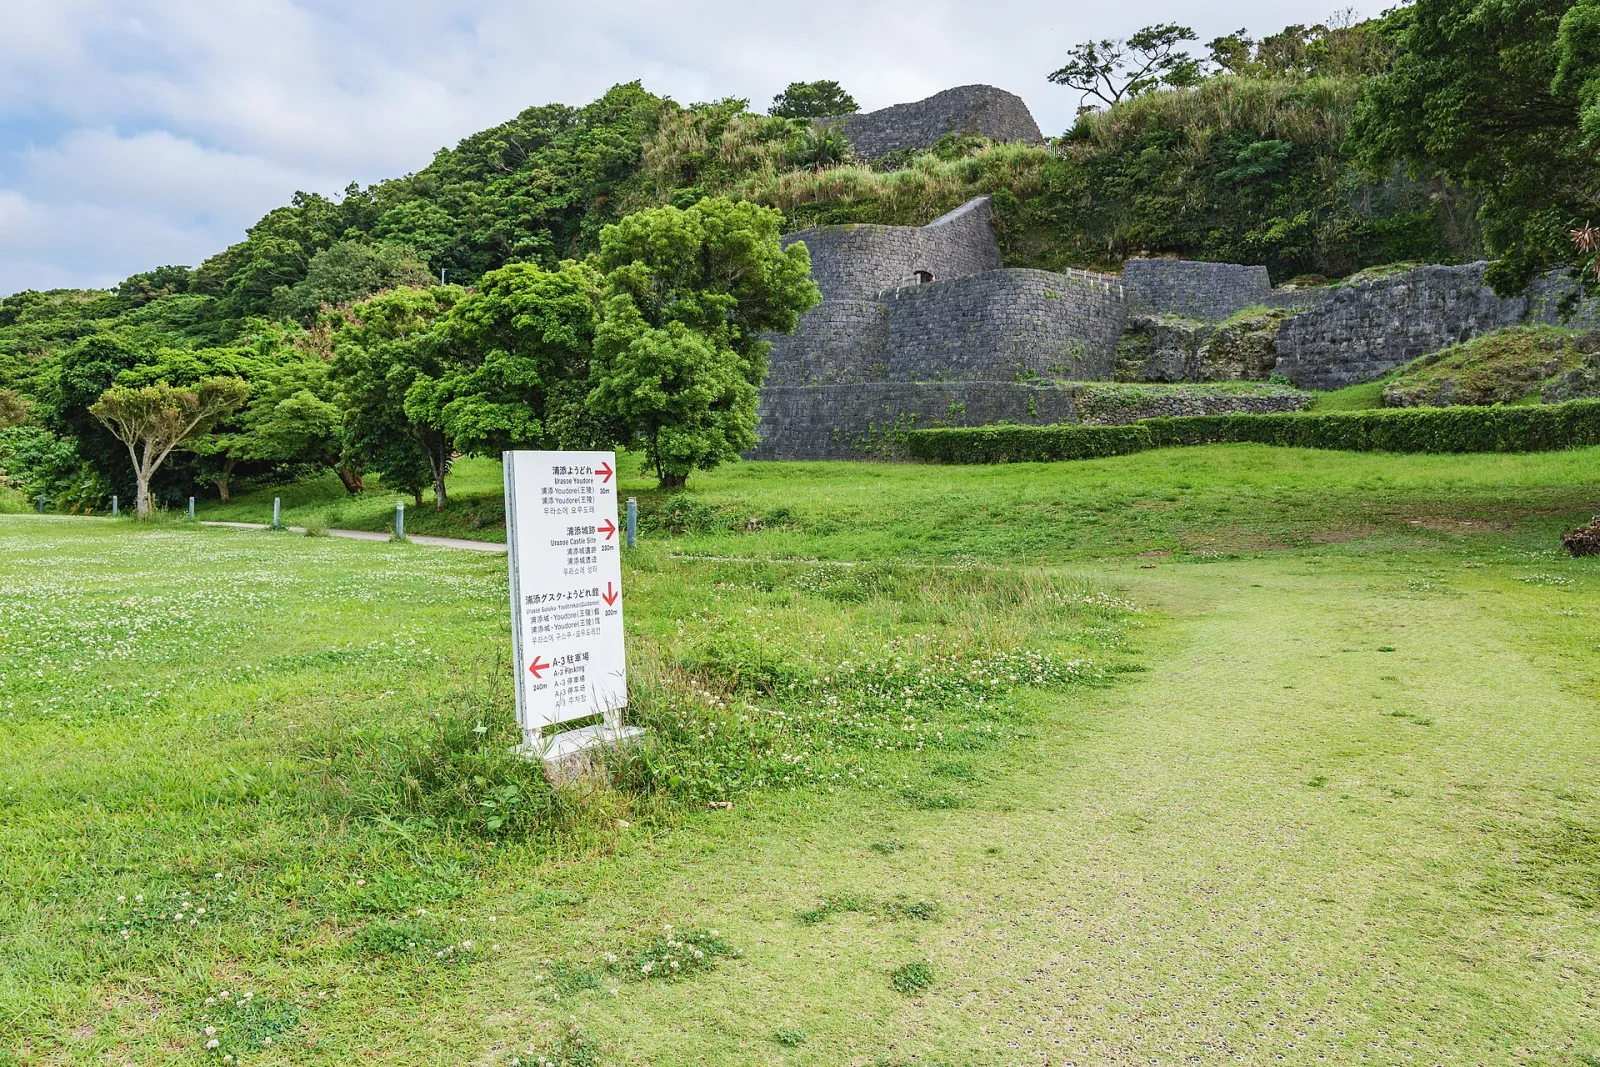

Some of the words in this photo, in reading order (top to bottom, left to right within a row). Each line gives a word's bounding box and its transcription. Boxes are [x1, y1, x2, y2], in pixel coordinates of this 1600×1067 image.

[552, 466, 593, 476] 浦添ようどれ
[566, 525, 596, 536] 浦添城跡
[550, 539, 569, 547] Urasoe
